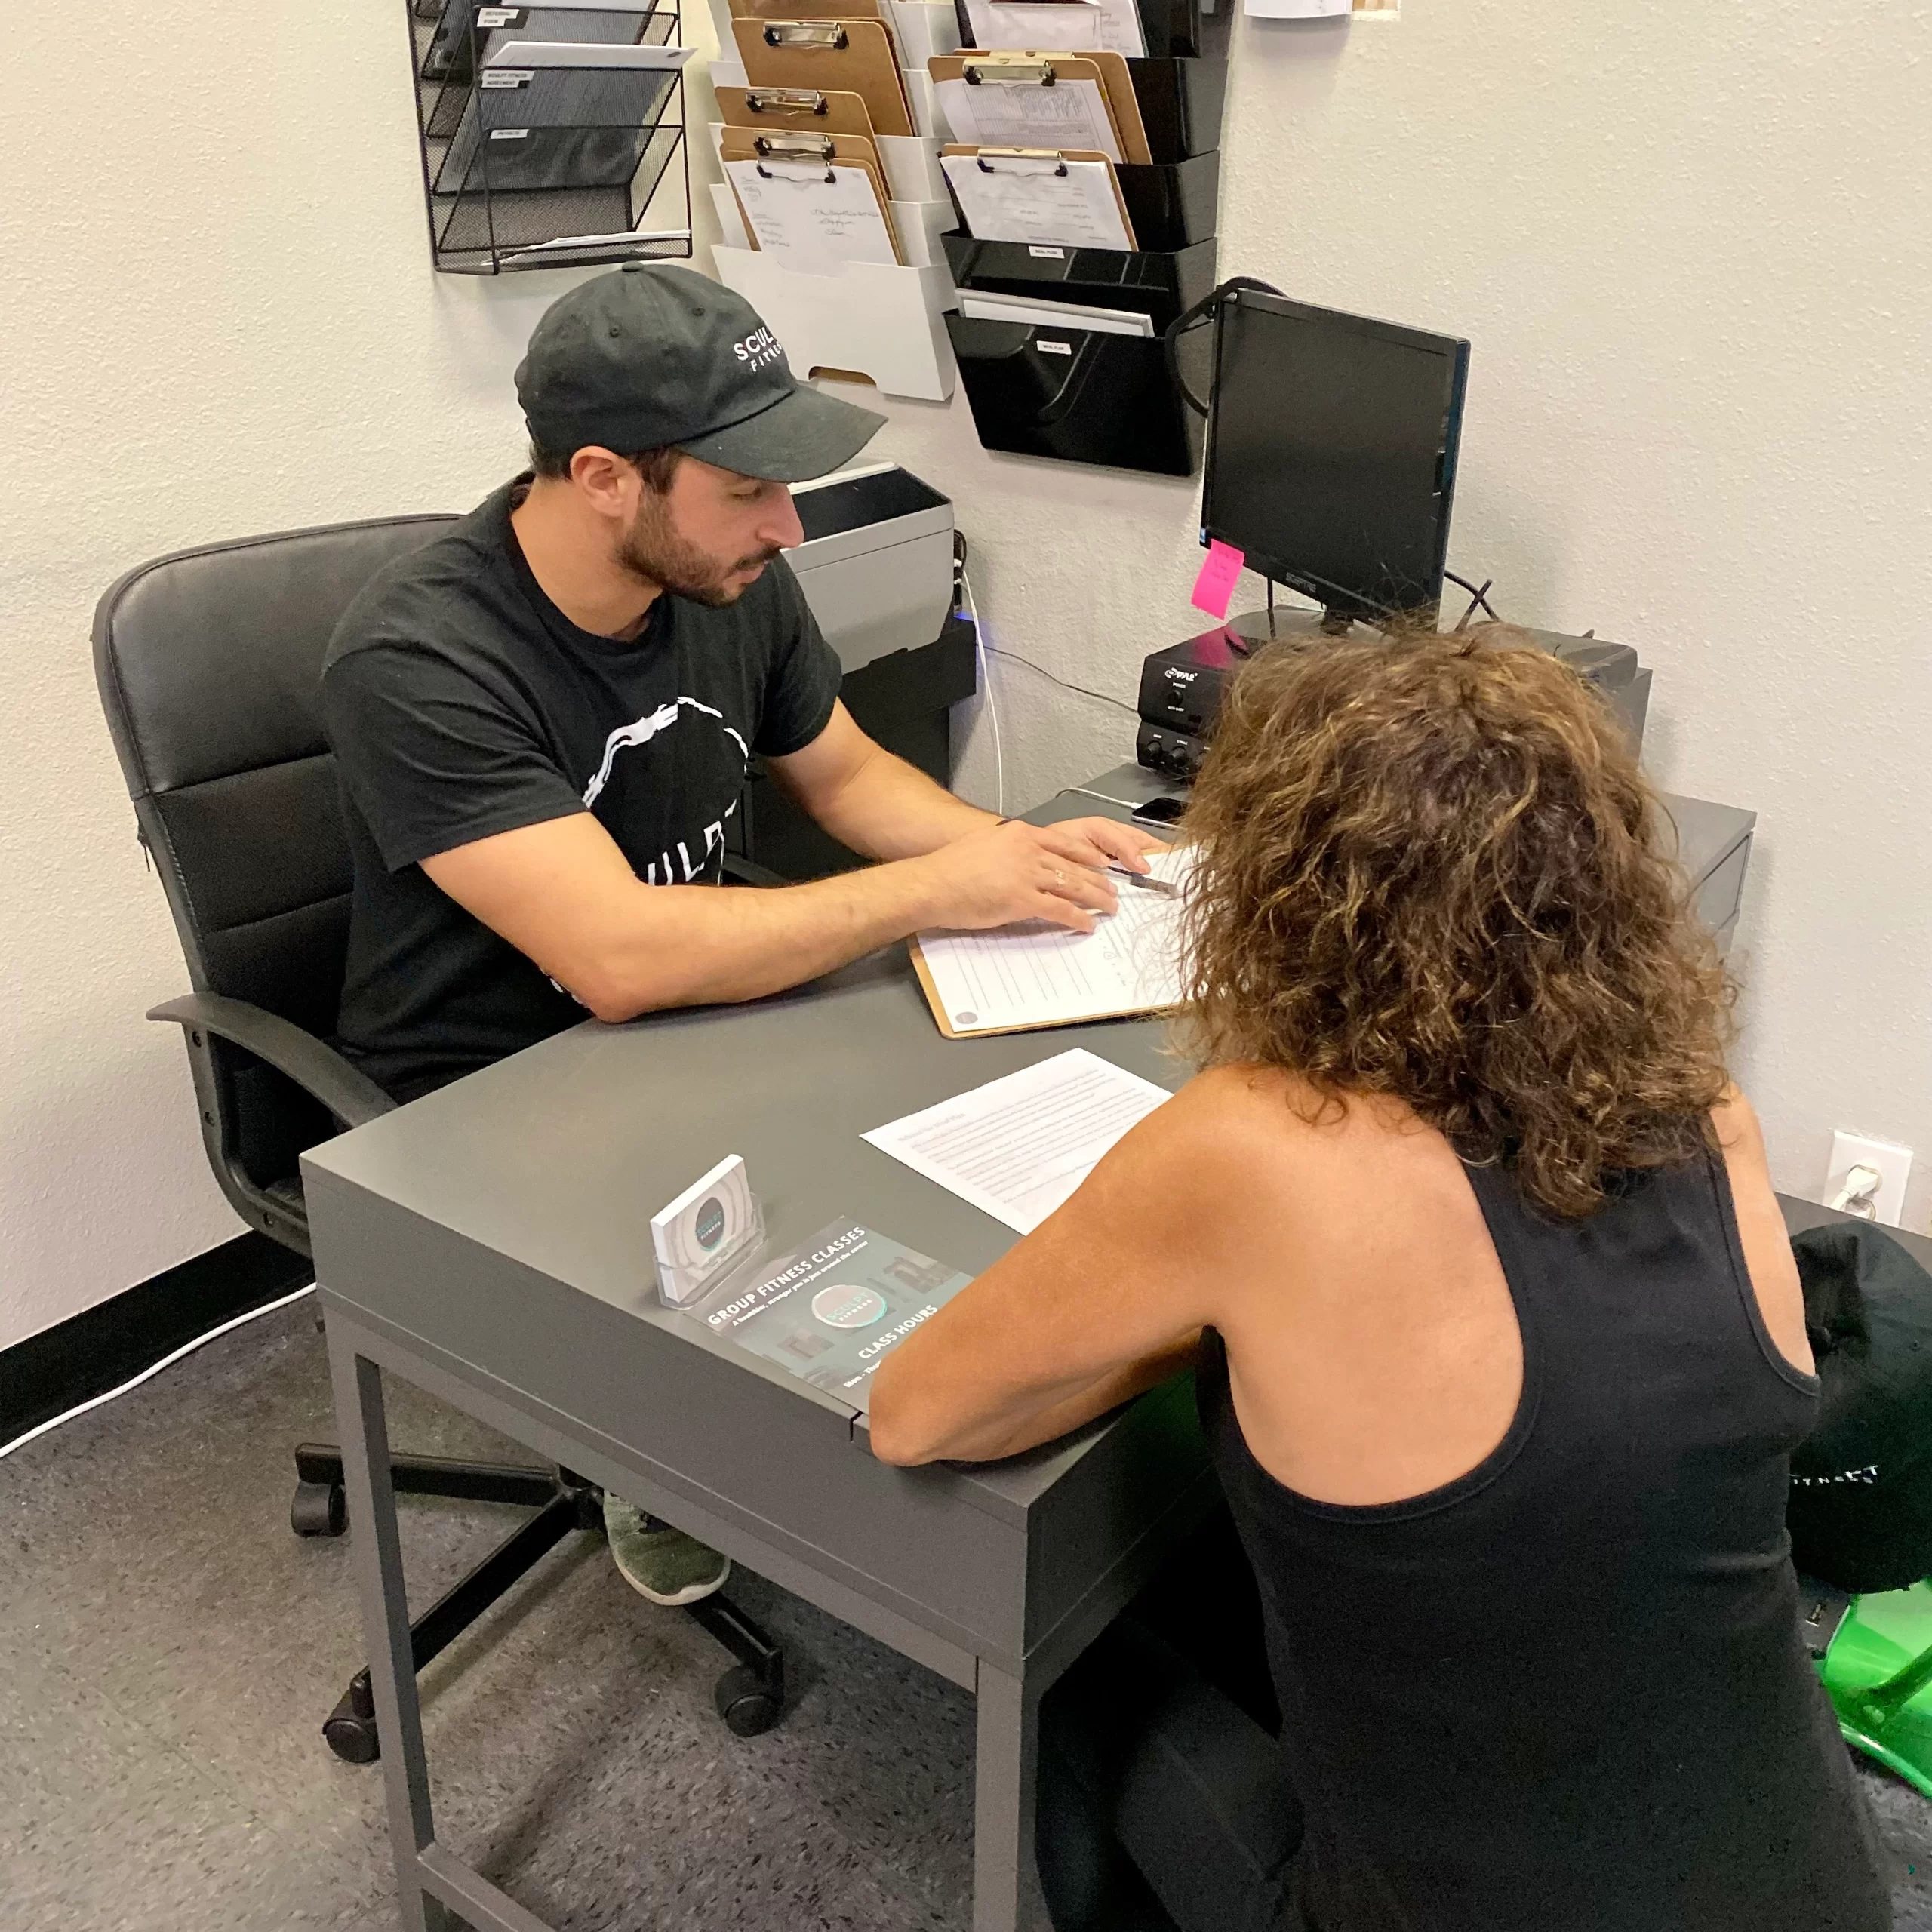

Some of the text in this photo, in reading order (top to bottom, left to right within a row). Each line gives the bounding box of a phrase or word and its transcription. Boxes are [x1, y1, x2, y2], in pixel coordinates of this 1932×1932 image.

[734, 326, 774, 361] SCUL
[708, 1226, 866, 1324] GROUP FITNESS CLASSES
[808, 1271, 821, 1281] just
[820, 1258, 841, 1272] around
[851, 1240, 868, 1254] corner
[858, 1304, 938, 1358] CLASS HOURS
